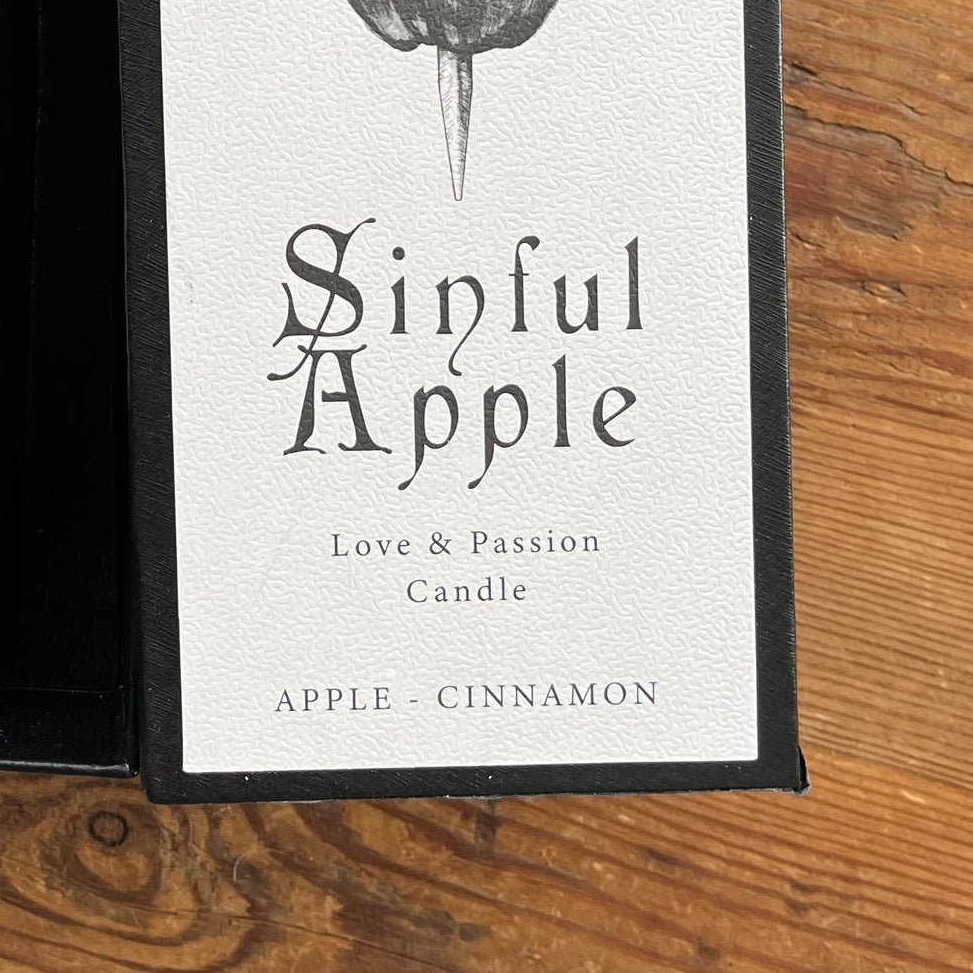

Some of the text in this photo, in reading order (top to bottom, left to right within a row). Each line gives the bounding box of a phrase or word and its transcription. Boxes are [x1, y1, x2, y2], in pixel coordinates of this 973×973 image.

[266, 217, 644, 383] Sinful
[280, 342, 637, 491] Apple
[330, 529, 600, 557] Love & Passion
[406, 576, 527, 604] Candle
[274, 686, 392, 713] APPLE
[437, 681, 658, 709] CINNAMON
